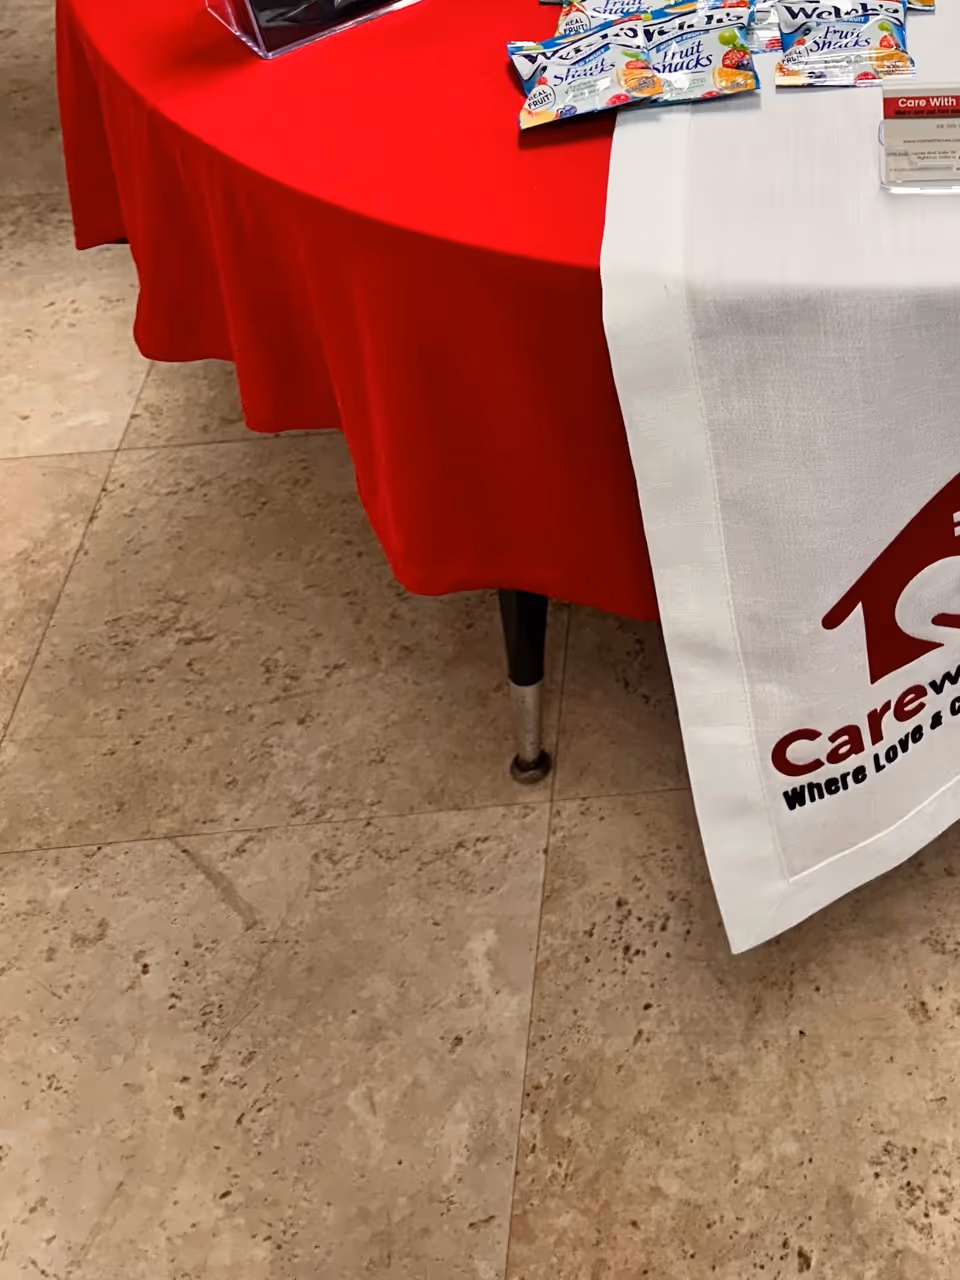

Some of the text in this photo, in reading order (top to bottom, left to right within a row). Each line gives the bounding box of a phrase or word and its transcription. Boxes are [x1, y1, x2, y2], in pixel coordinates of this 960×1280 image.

[663, 40, 704, 61] Fruit
[810, 37, 871, 52] Snacks
[652, 54, 713, 74] Snacks
[527, 93, 552, 109] FRUIT!
[898, 98, 926, 108] Care
[929, 96, 956, 107] With
[771, 684, 928, 777] Care
[782, 765, 868, 811] Where
[874, 725, 924, 773] Love
[929, 710, 944, 730] &
